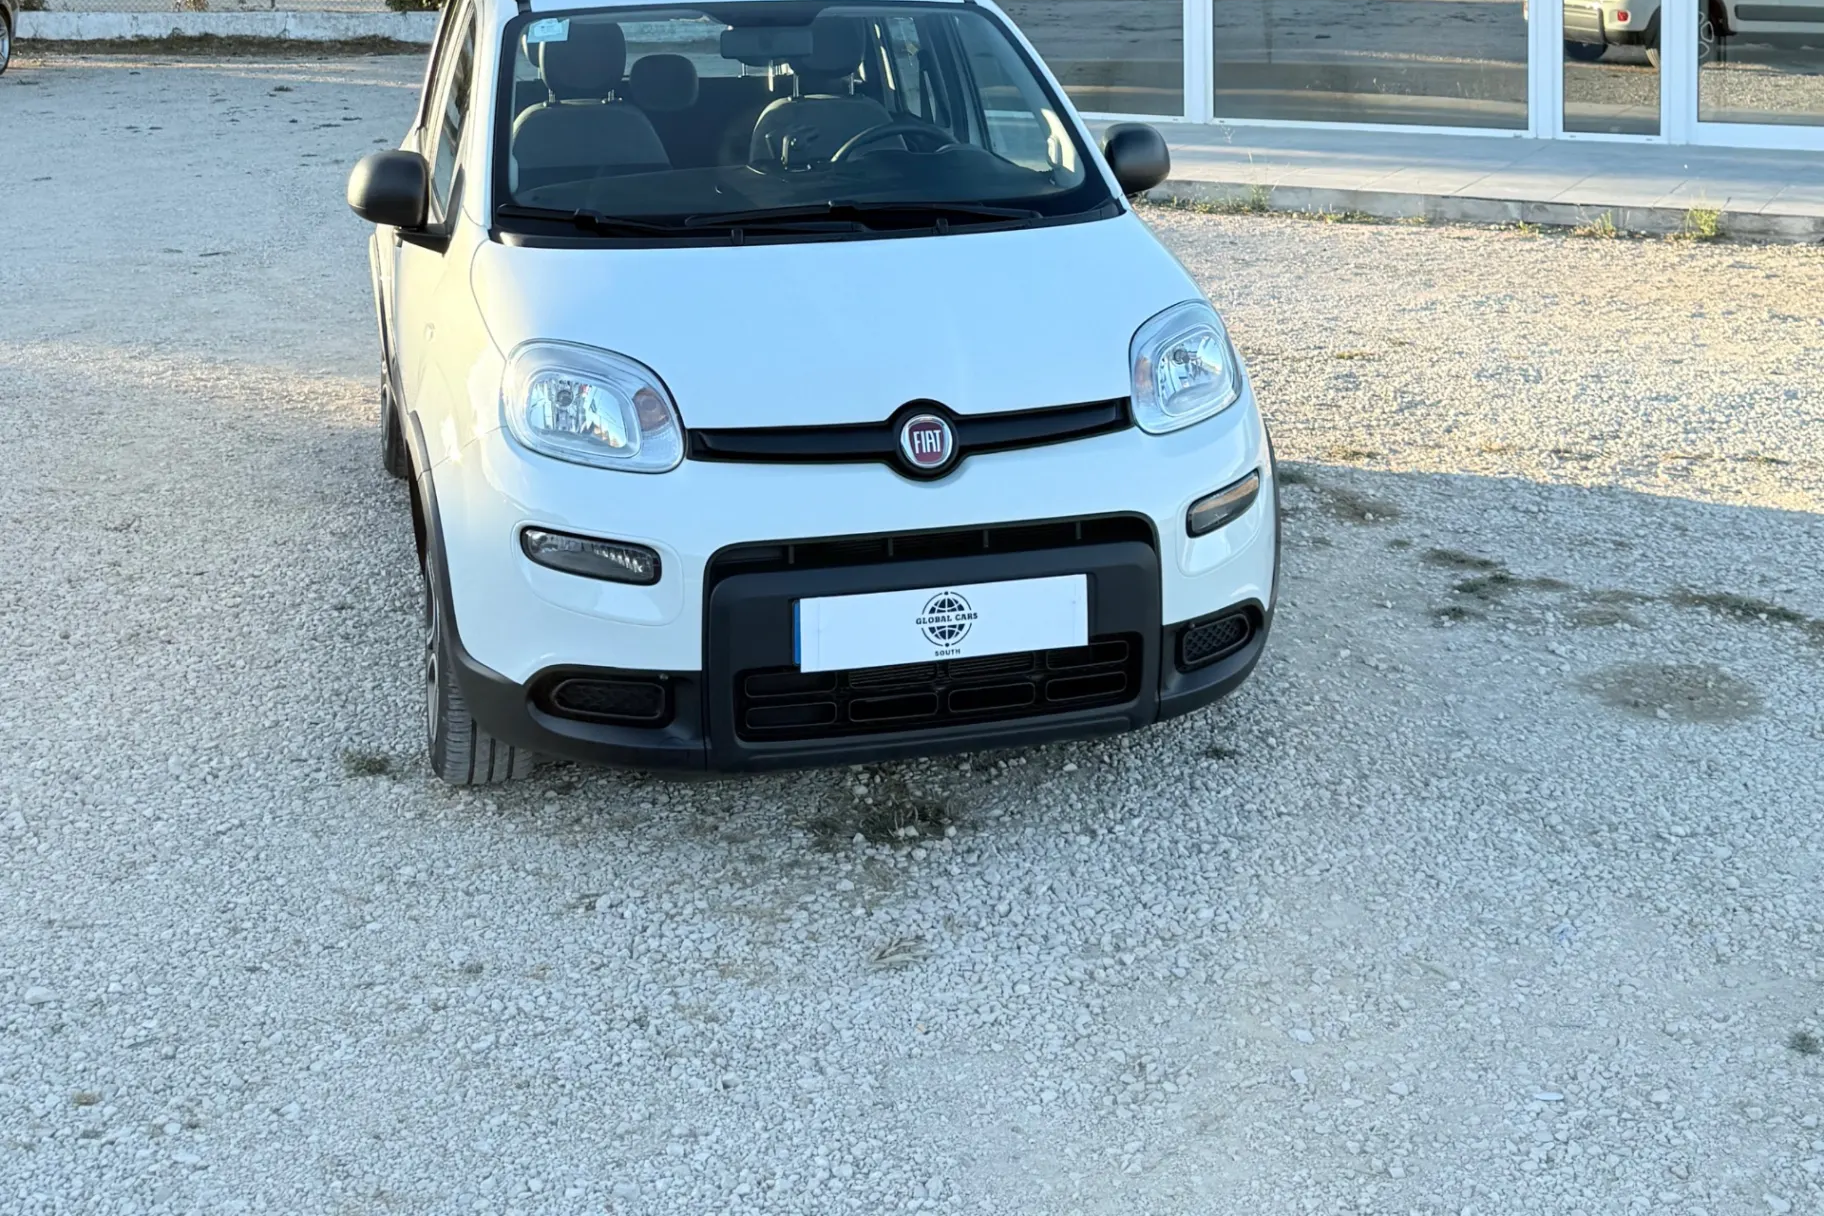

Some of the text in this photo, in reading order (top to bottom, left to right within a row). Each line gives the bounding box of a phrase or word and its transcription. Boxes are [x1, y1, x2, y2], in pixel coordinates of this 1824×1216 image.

[912, 429, 942, 454] FIAT
[915, 612, 978, 625] GLOBAL CARS
[934, 648, 961, 657] SOUTH
